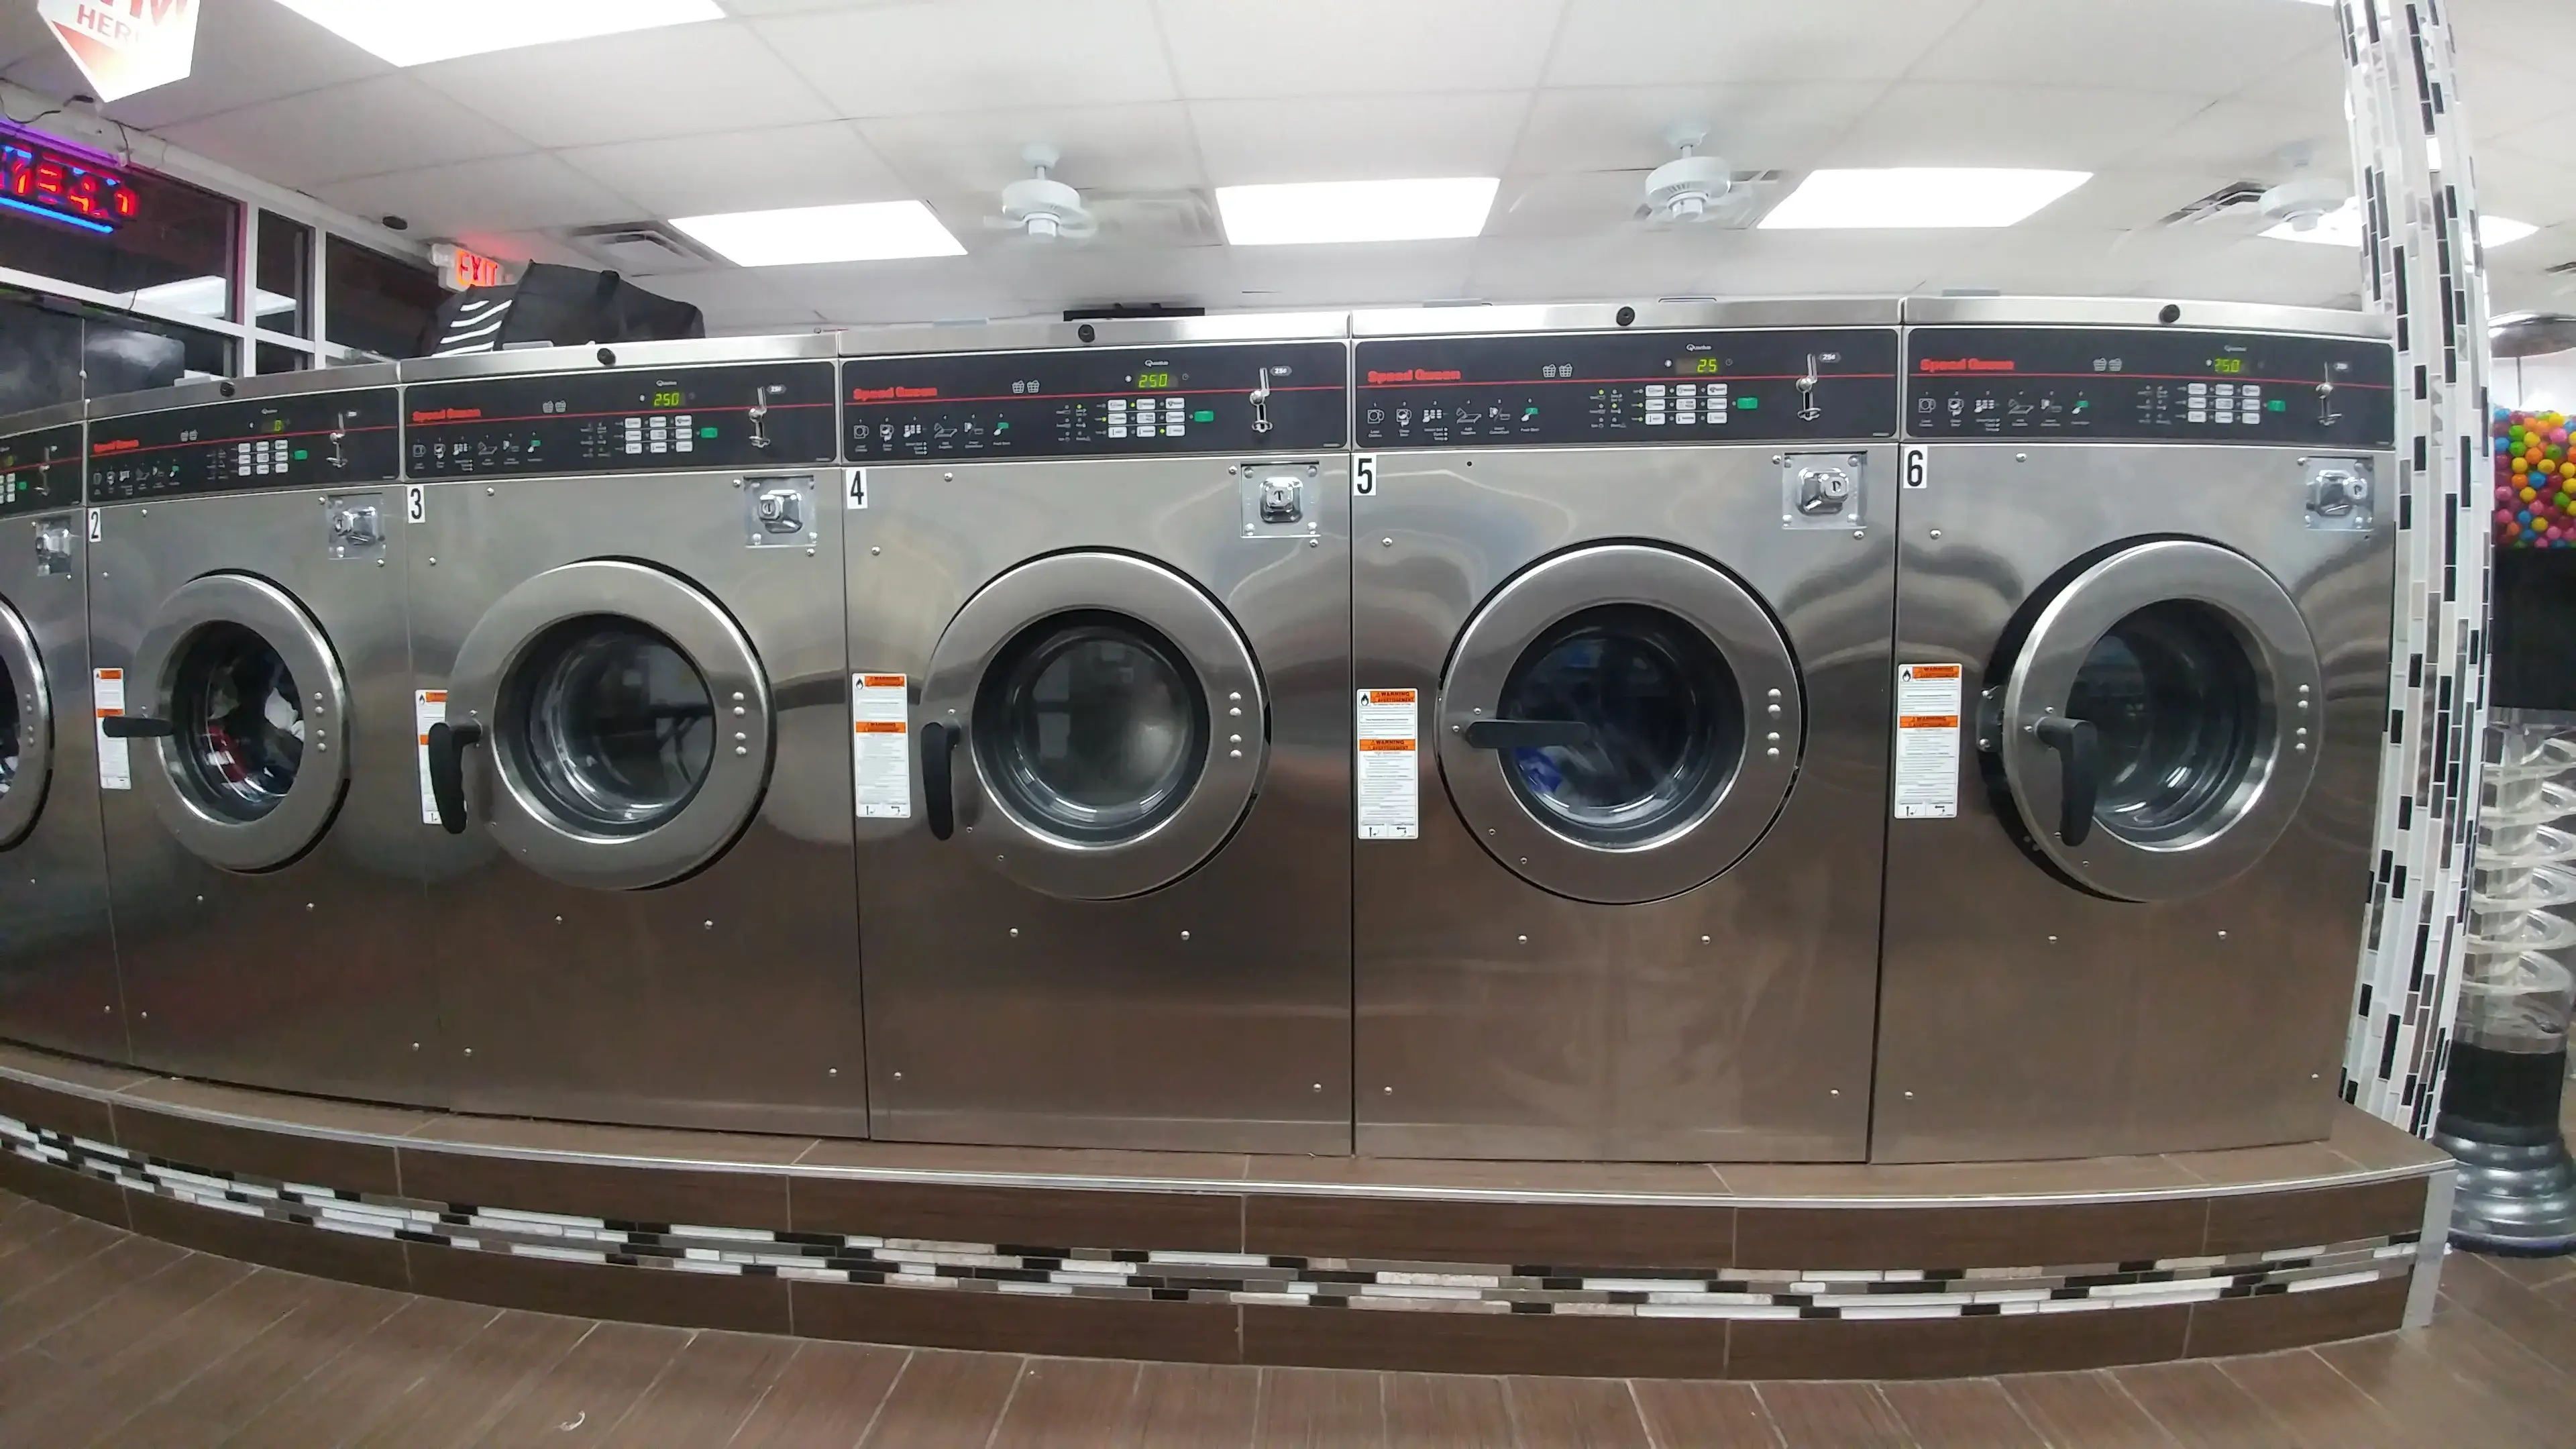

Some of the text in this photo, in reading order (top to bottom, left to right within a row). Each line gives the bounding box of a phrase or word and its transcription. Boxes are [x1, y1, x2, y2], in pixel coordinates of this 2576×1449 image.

[76, 4, 140, 44] HER
[457, 250, 498, 286] EXIT
[1138, 373, 1168, 388] 250
[1697, 358, 1717, 372] 25
[654, 392, 680, 407] 250
[1357, 458, 1373, 494] 5
[1907, 450, 1923, 487] 6
[411, 488, 422, 520] 3
[851, 470, 865, 505] 4
[91, 511, 99, 539] 2
